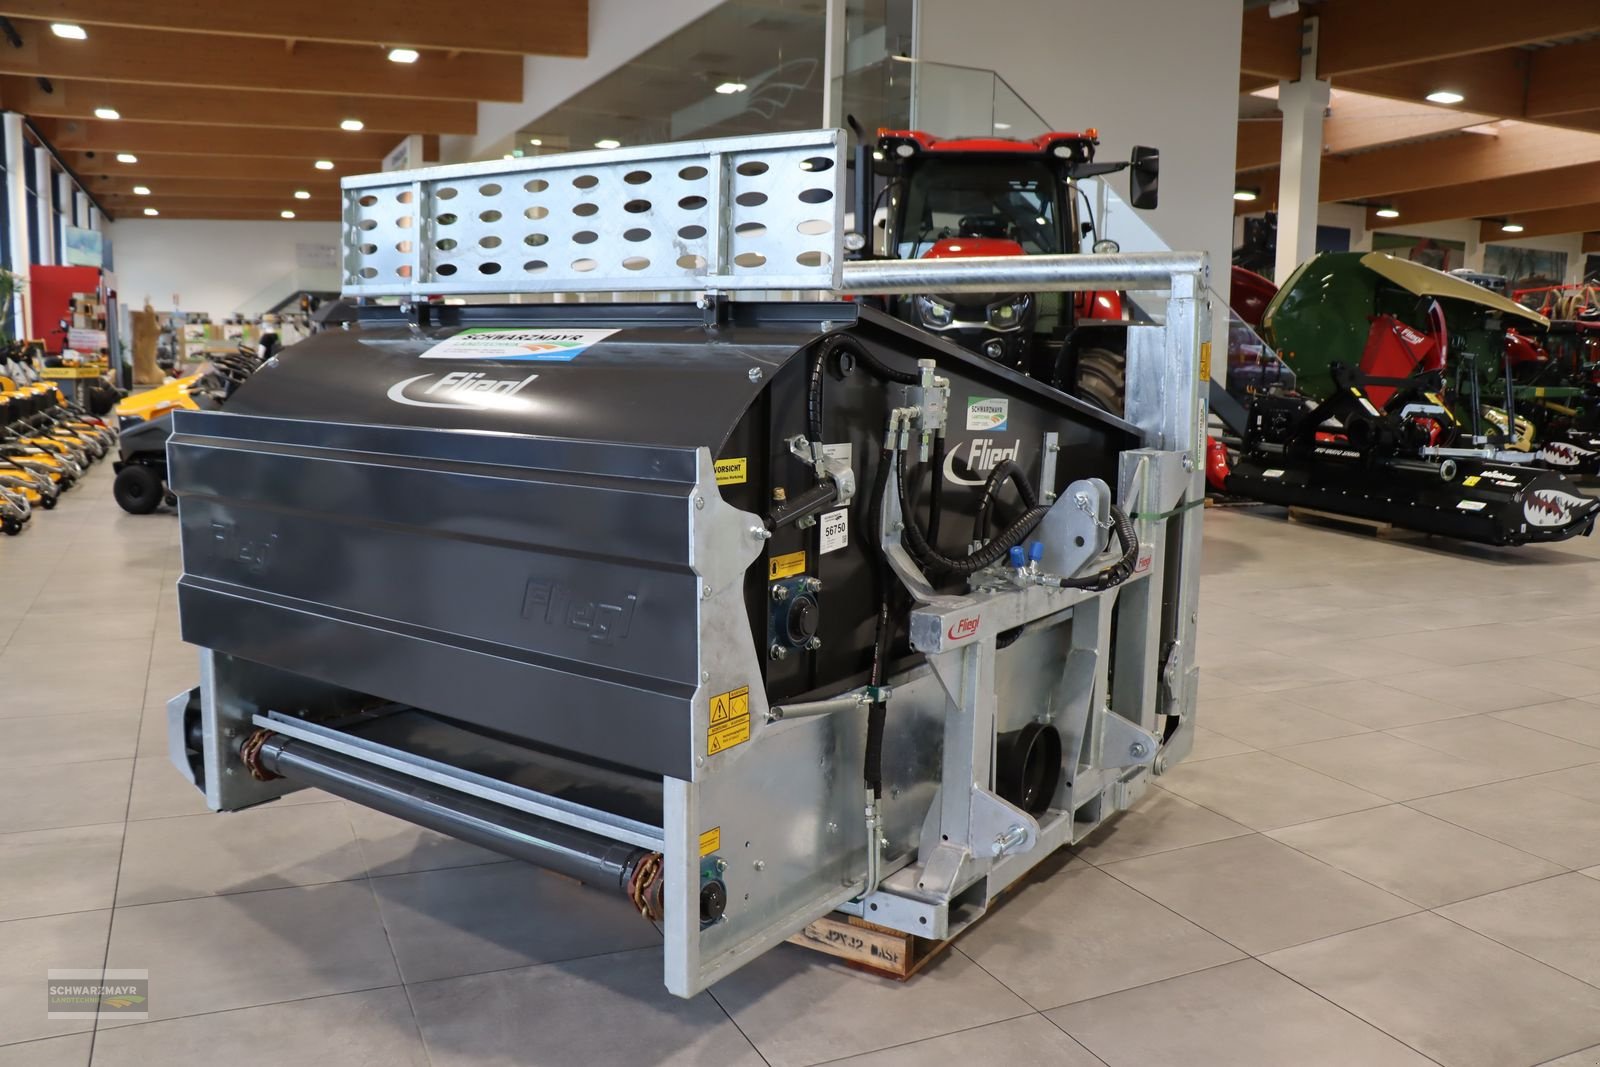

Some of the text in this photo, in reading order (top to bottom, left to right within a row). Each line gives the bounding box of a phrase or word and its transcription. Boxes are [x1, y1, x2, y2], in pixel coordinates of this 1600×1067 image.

[463, 333, 584, 342] SCHWARZMAYR
[971, 405, 1003, 414] SCHWARZMAYR
[714, 464, 741, 473] VORSICHT
[825, 522, 846, 537] 56750
[521, 576, 637, 645] Fliegl
[957, 614, 981, 633] Fliegl
